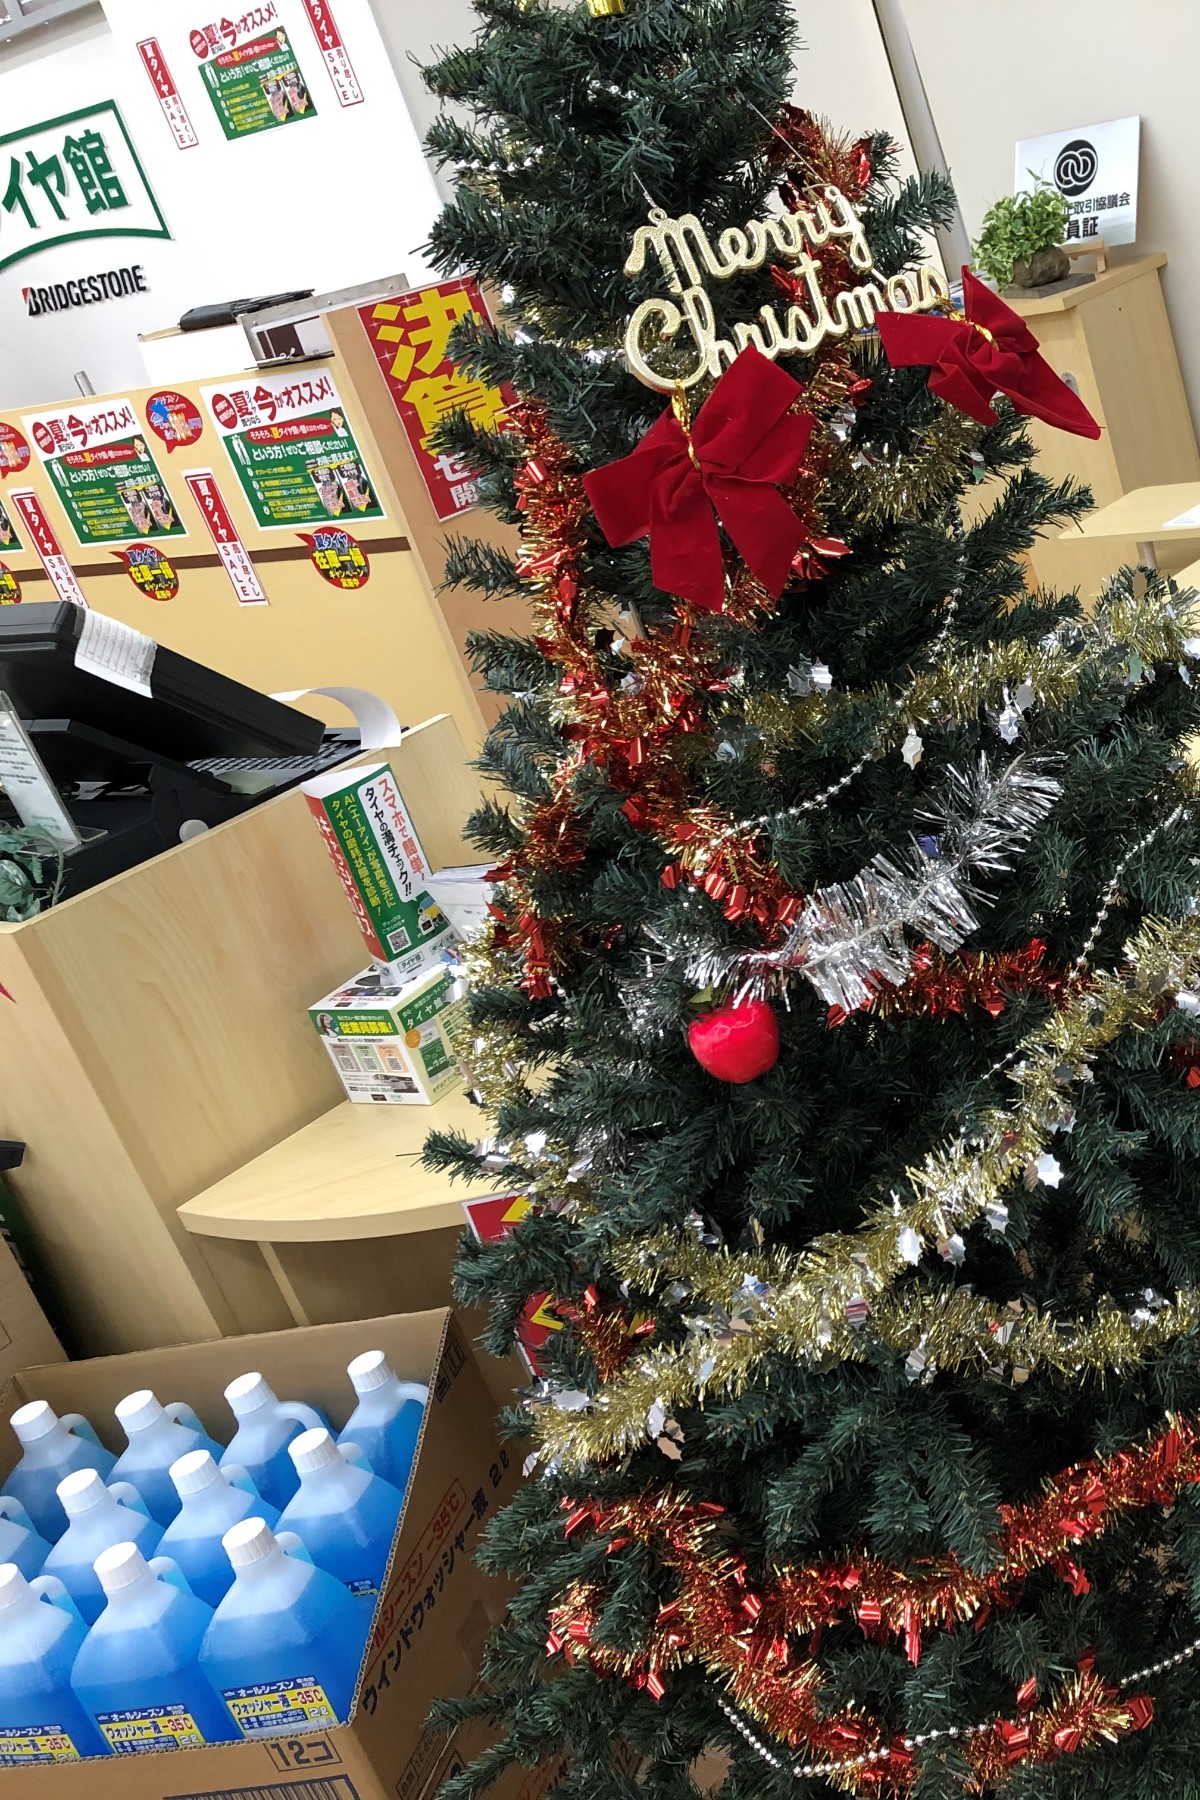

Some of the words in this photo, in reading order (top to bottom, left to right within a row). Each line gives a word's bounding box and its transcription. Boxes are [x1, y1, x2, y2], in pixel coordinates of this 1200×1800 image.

[143, 43, 170, 96] 夏タイヤ
[328, 53, 350, 101] SALE
[164, 99, 187, 144] SALE
[1, 129, 130, 229] イヤ館
[624, 185, 874, 294] Merry
[22, 265, 147, 316] BRIDGESTONE
[625, 249, 950, 394] Christmas
[23, 499, 53, 555] 夏タイヤ
[198, 480, 228, 542] 夏タイヤ
[223, 546, 249, 596] SALE
[231, 543, 260, 597] 売り尽くし
[364, 787, 412, 897] タイヤの溝チェック!!
[362, 1487, 489, 1717] ウインドウォッシャー液
[110, 1708, 165, 1722] オールシーズン
[231, 1694, 291, 1716] ウォッシャー液
[237, 1681, 294, 1698] オールシーズン
[270, 1740, 334, 1767] 12コ
